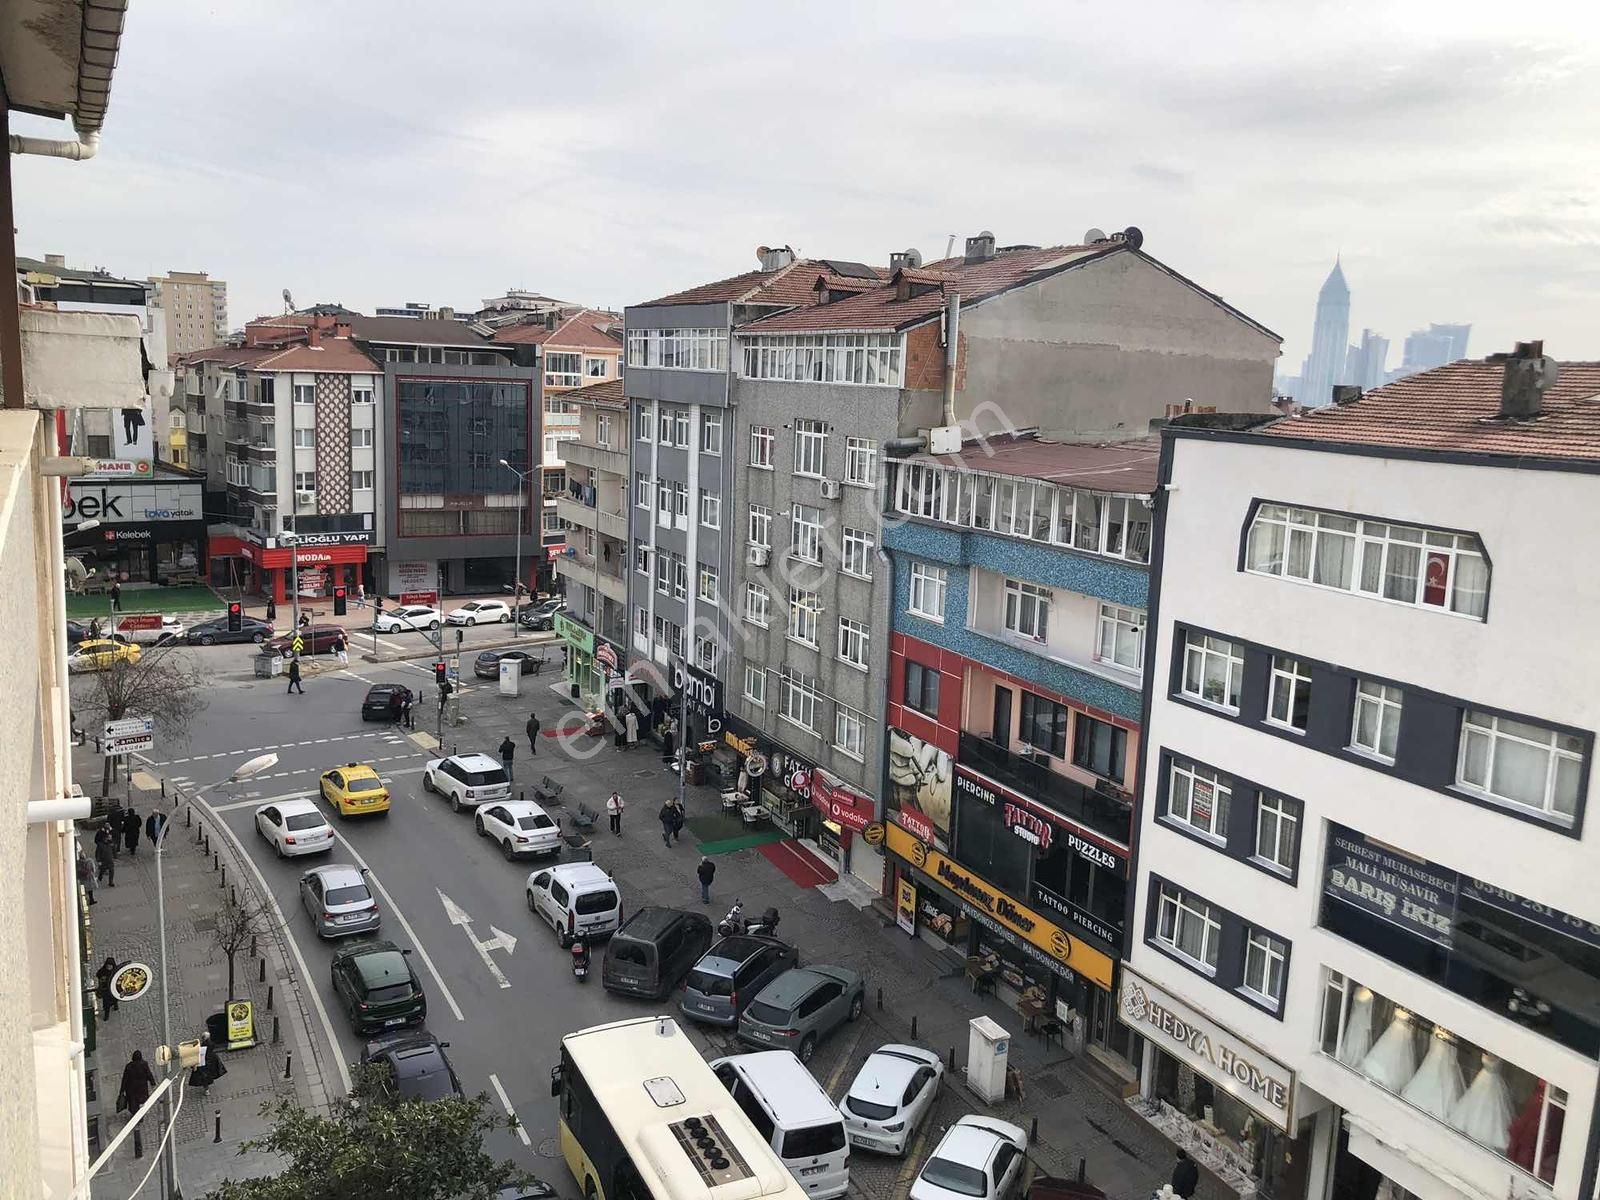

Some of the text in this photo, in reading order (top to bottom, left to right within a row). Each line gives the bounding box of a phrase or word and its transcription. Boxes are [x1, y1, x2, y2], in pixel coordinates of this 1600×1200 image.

[116, 530, 152, 539] Kelebek
[343, 534, 369, 542] YAPI
[957, 776, 996, 805] PIERCING
[1014, 825, 1041, 846] STUDIO
[1068, 834, 1116, 869] PUZZLES
[1335, 837, 1382, 863] SERBEST
[1345, 856, 1378, 878] MALİ
[1331, 869, 1451, 936] BARIŞ İKİZ
[1038, 890, 1113, 943] TATTOO PIERCING
[1148, 1001, 1287, 1109] HEDYA HOME
